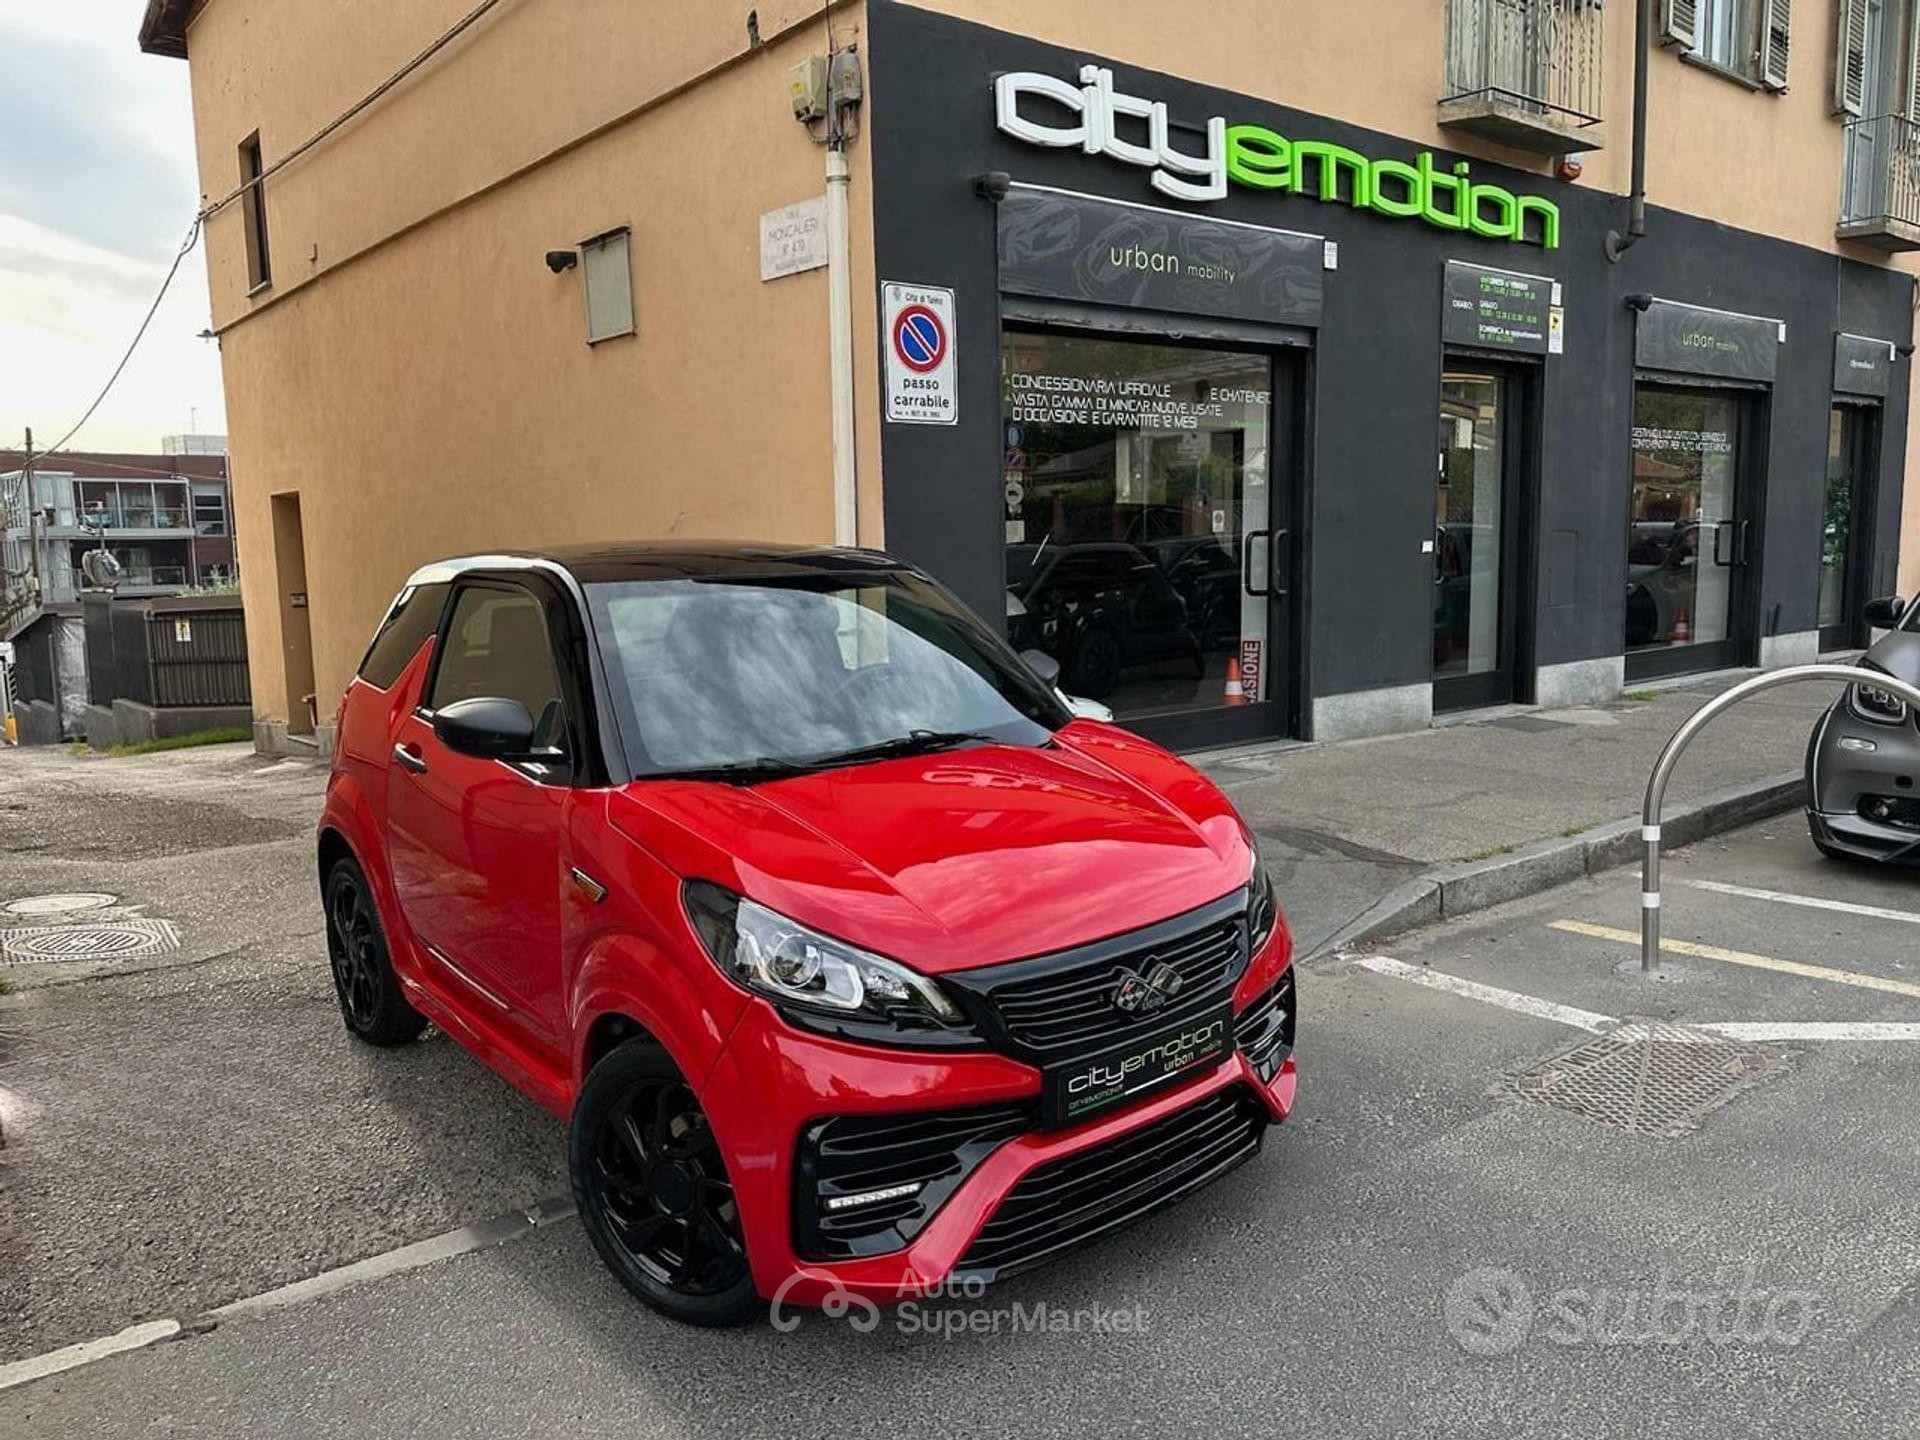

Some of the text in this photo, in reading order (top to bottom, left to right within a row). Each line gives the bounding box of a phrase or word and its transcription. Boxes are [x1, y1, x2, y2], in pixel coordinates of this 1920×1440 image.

[996, 64, 1559, 249] cityemotion
[1110, 244, 1235, 283] urban mobility
[903, 378, 939, 390] passo
[1011, 373, 1117, 395] CONCESSIONARIA
[893, 394, 949, 408] carrabile
[1012, 392, 1049, 407] VASTA
[1051, 394, 1093, 409] GAMMA
[1092, 409, 1100, 424] E
[1102, 411, 1159, 427] GARANTITE
[1068, 1019, 1224, 1093] cityemotion
[1163, 1051, 1194, 1071] urban
